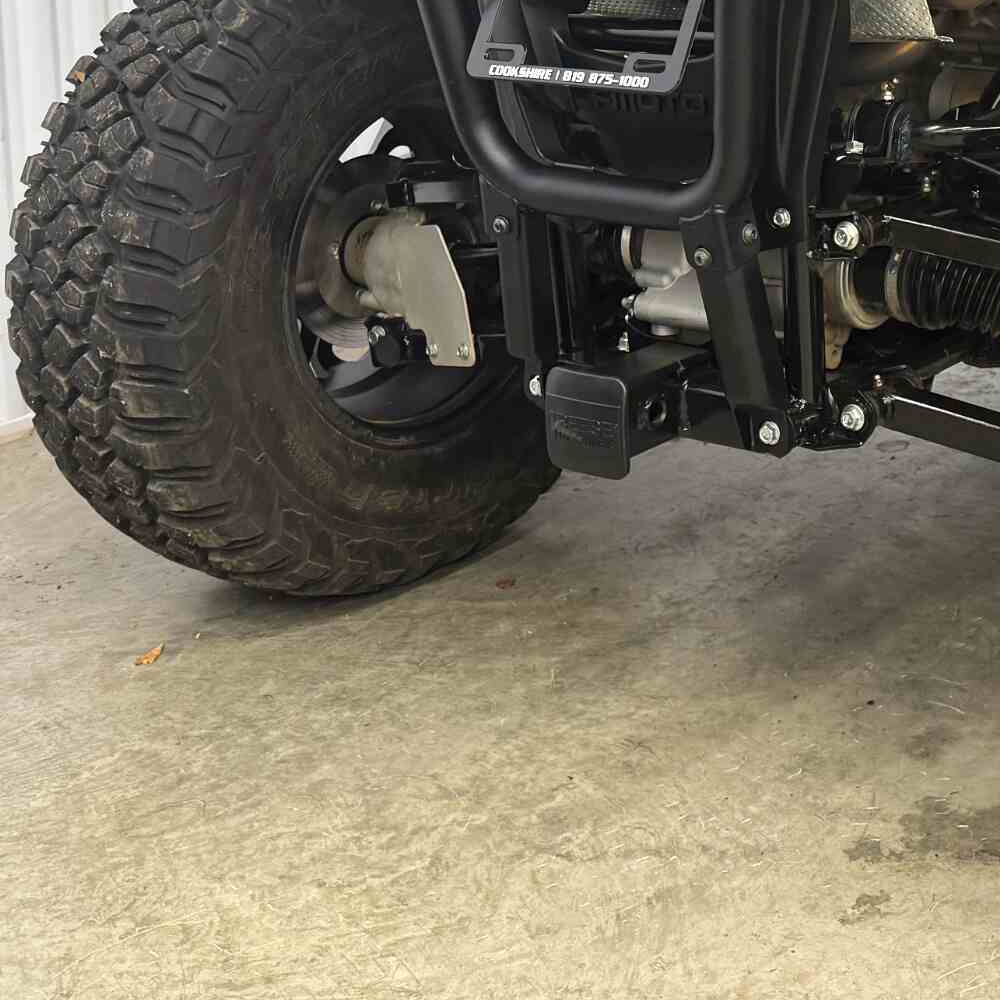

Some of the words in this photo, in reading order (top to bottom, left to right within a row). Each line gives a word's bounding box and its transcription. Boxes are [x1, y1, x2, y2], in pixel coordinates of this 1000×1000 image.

[488, 64, 553, 81] COOKSHIRE
[562, 70, 585, 83] 819
[588, 72, 650, 88] 875-1000
